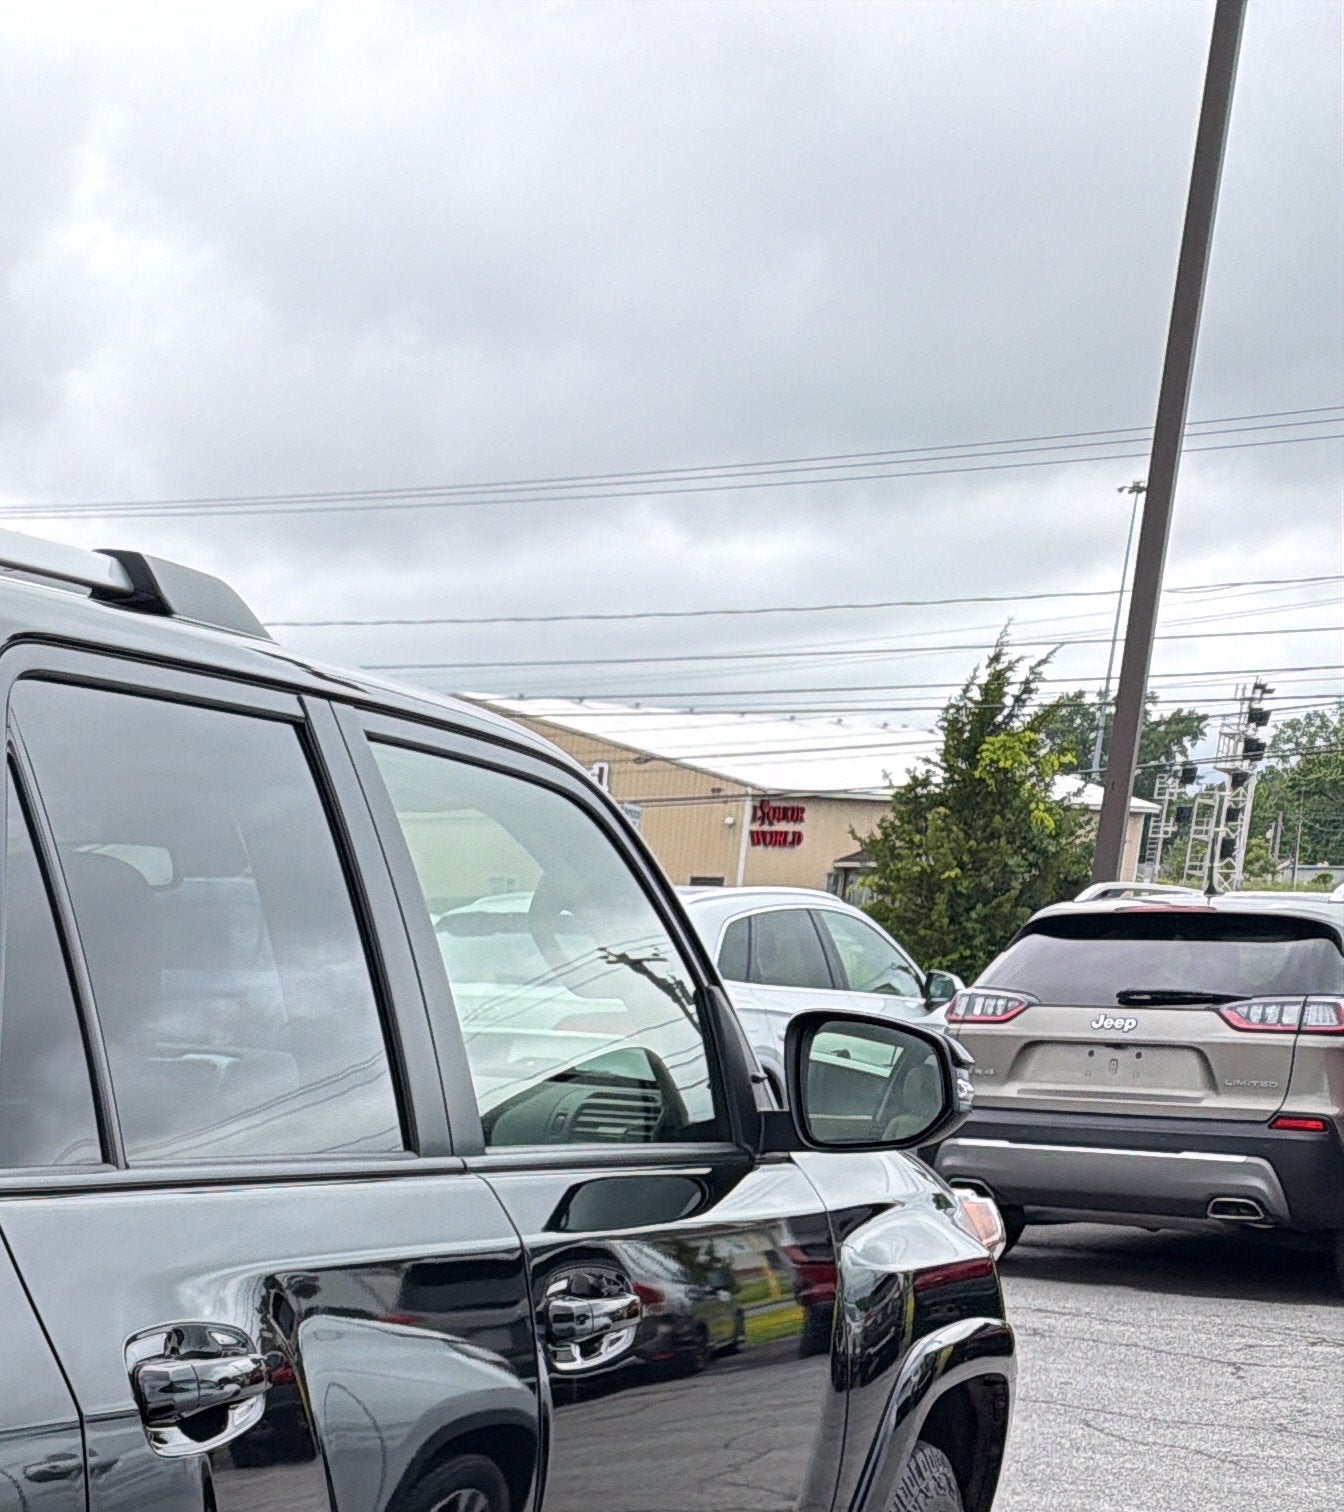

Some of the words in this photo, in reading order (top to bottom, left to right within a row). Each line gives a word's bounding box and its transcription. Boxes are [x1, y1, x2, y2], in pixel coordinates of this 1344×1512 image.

[749, 830, 804, 848] WORLD
[1091, 1014, 1138, 1032] Jeep
[1224, 1079, 1279, 1088] LIMITED
